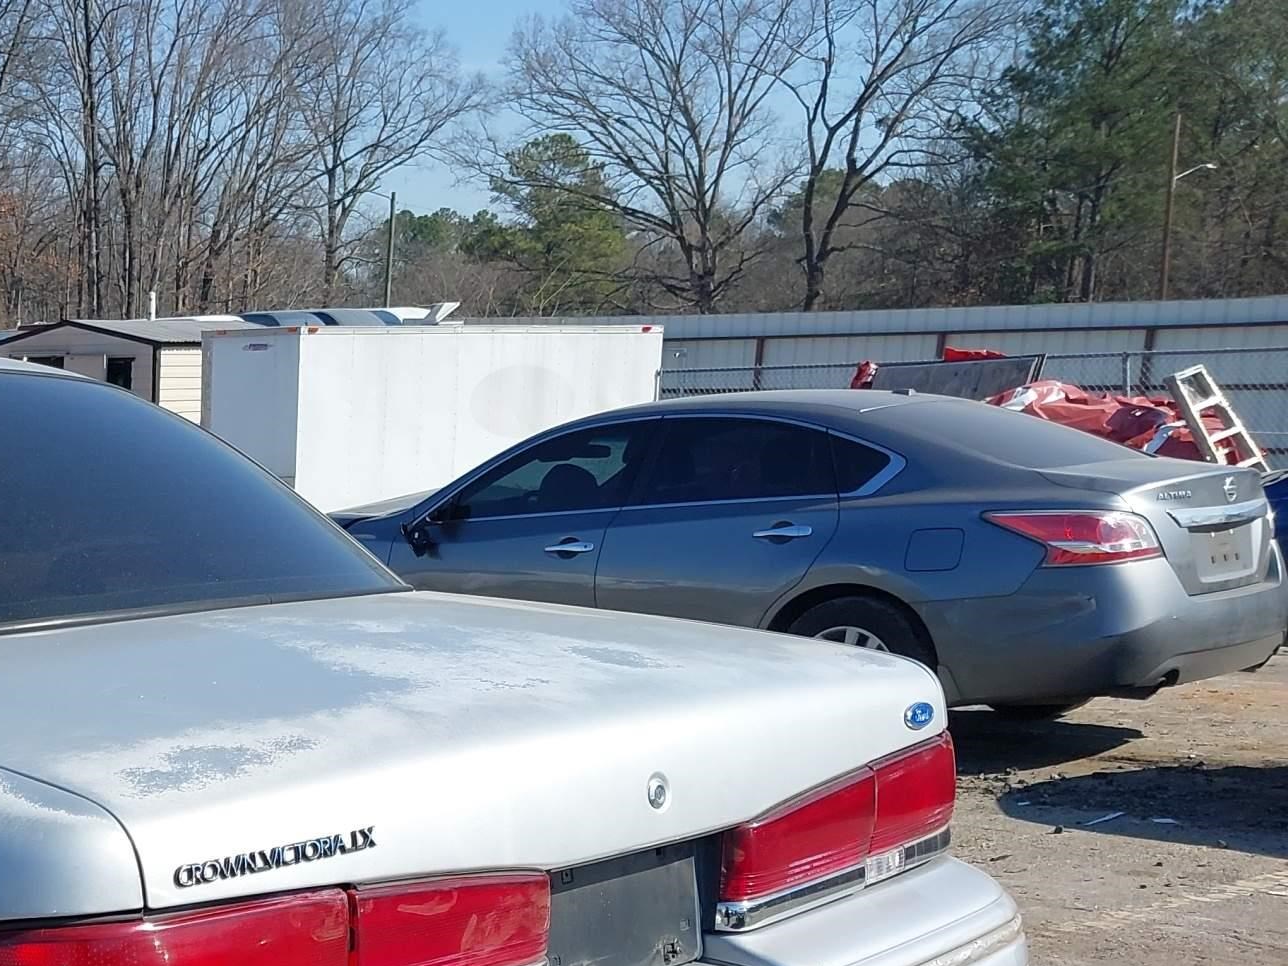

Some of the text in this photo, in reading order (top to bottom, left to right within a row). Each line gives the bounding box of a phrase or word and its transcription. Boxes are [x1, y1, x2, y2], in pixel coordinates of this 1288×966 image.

[1156, 490, 1192, 500] ALTIMA
[173, 825, 377, 888] CROWN VICTORIA LX
